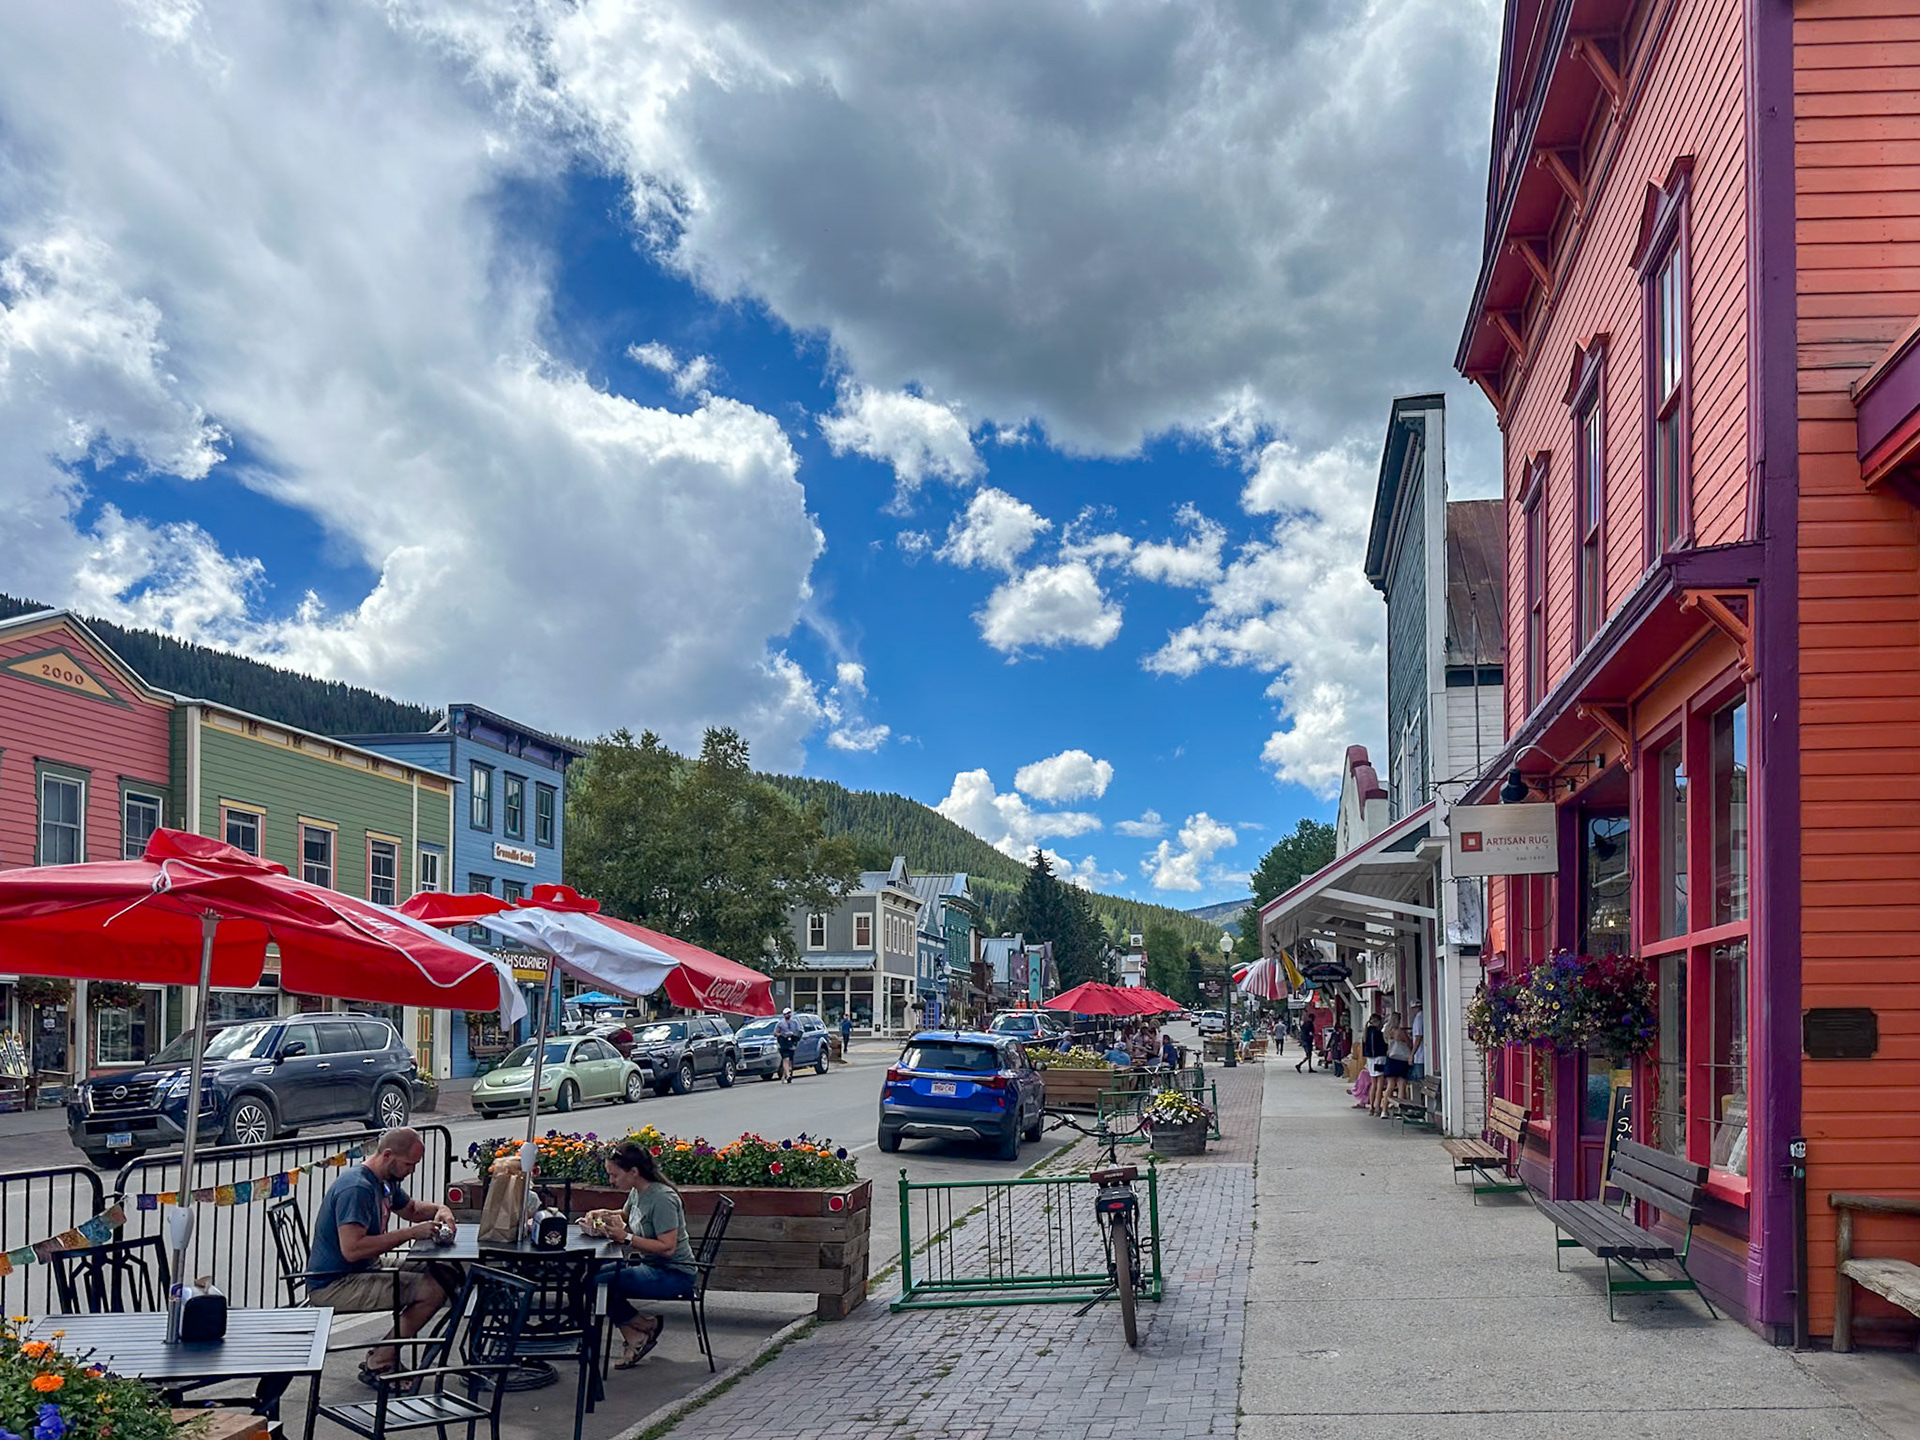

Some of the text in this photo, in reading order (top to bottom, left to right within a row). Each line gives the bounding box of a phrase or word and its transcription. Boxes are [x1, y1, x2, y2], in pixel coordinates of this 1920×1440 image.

[42, 664, 84, 685] 2000
[1486, 836, 1549, 846] ARTISAN RUG
[519, 956, 548, 970] CORNER
